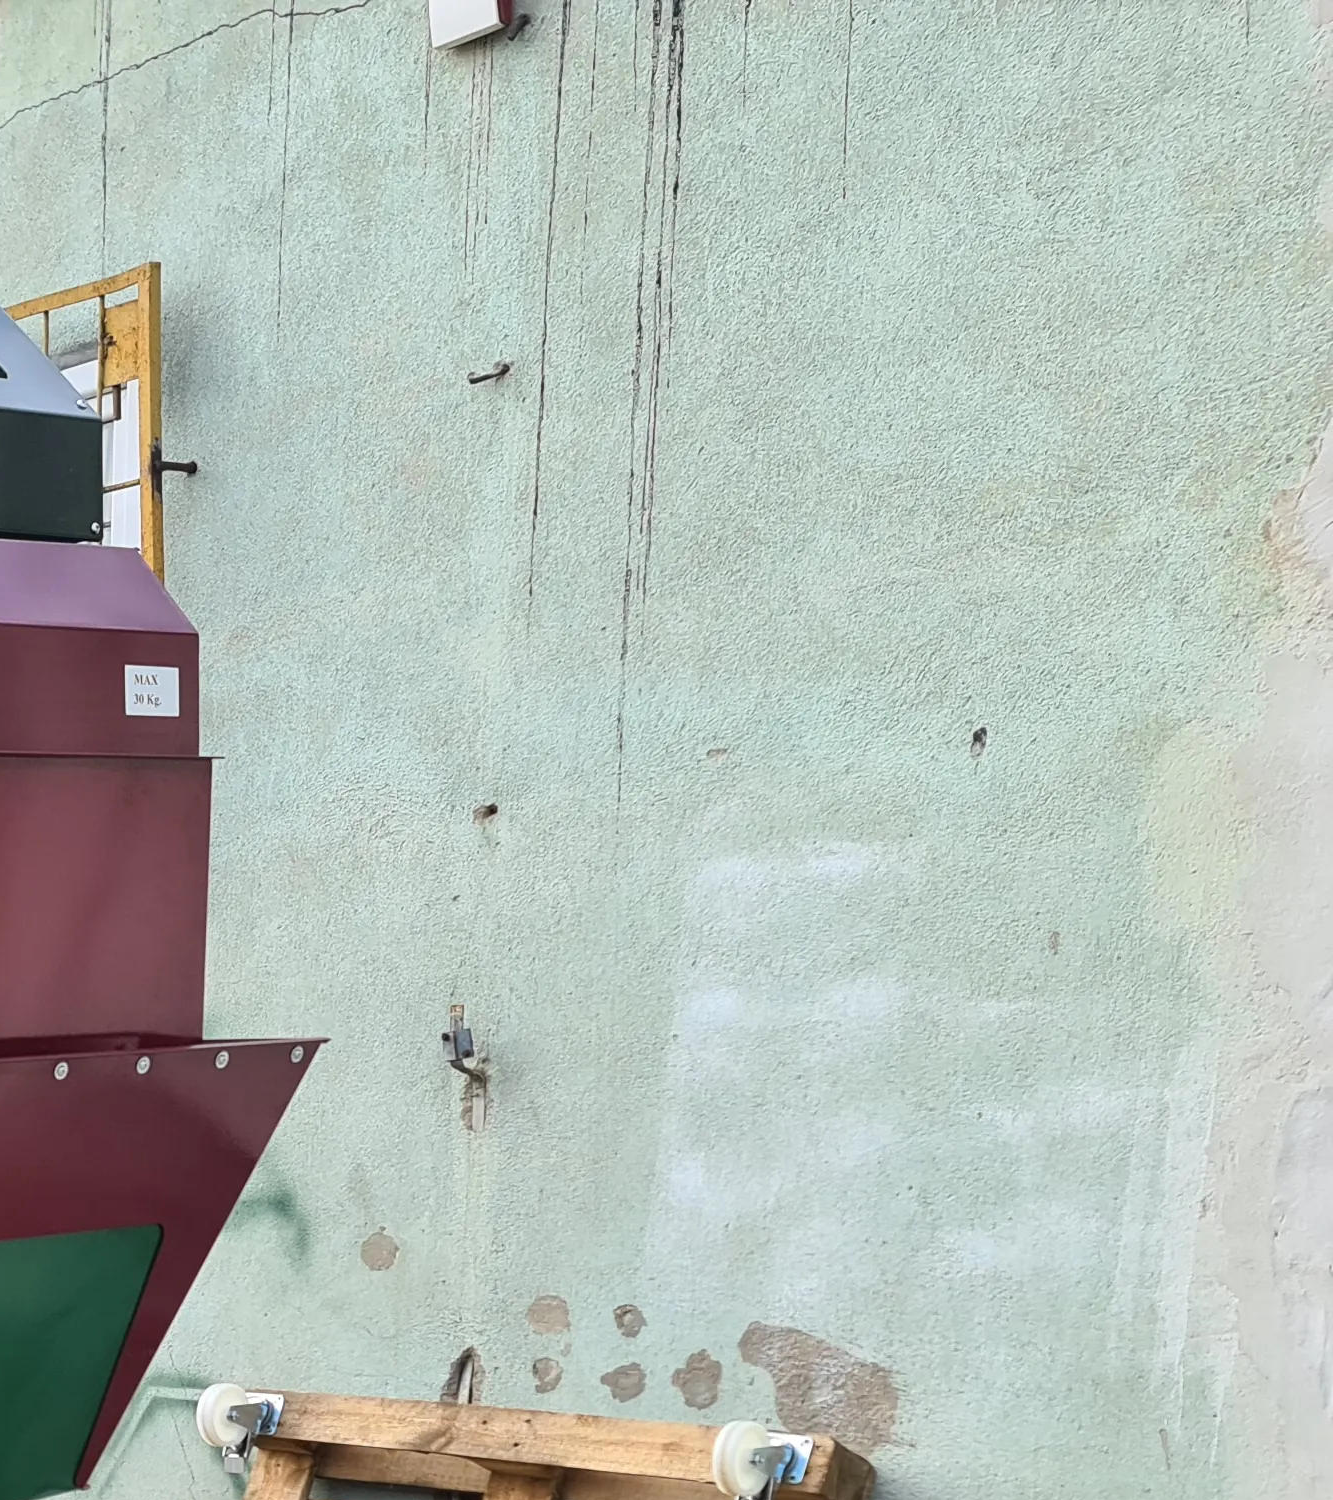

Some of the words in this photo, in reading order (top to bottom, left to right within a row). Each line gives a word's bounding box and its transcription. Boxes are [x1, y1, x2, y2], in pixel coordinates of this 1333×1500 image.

[133, 673, 158, 686] MAX
[133, 693, 144, 705] 30
[147, 693, 162, 708] Kg.
